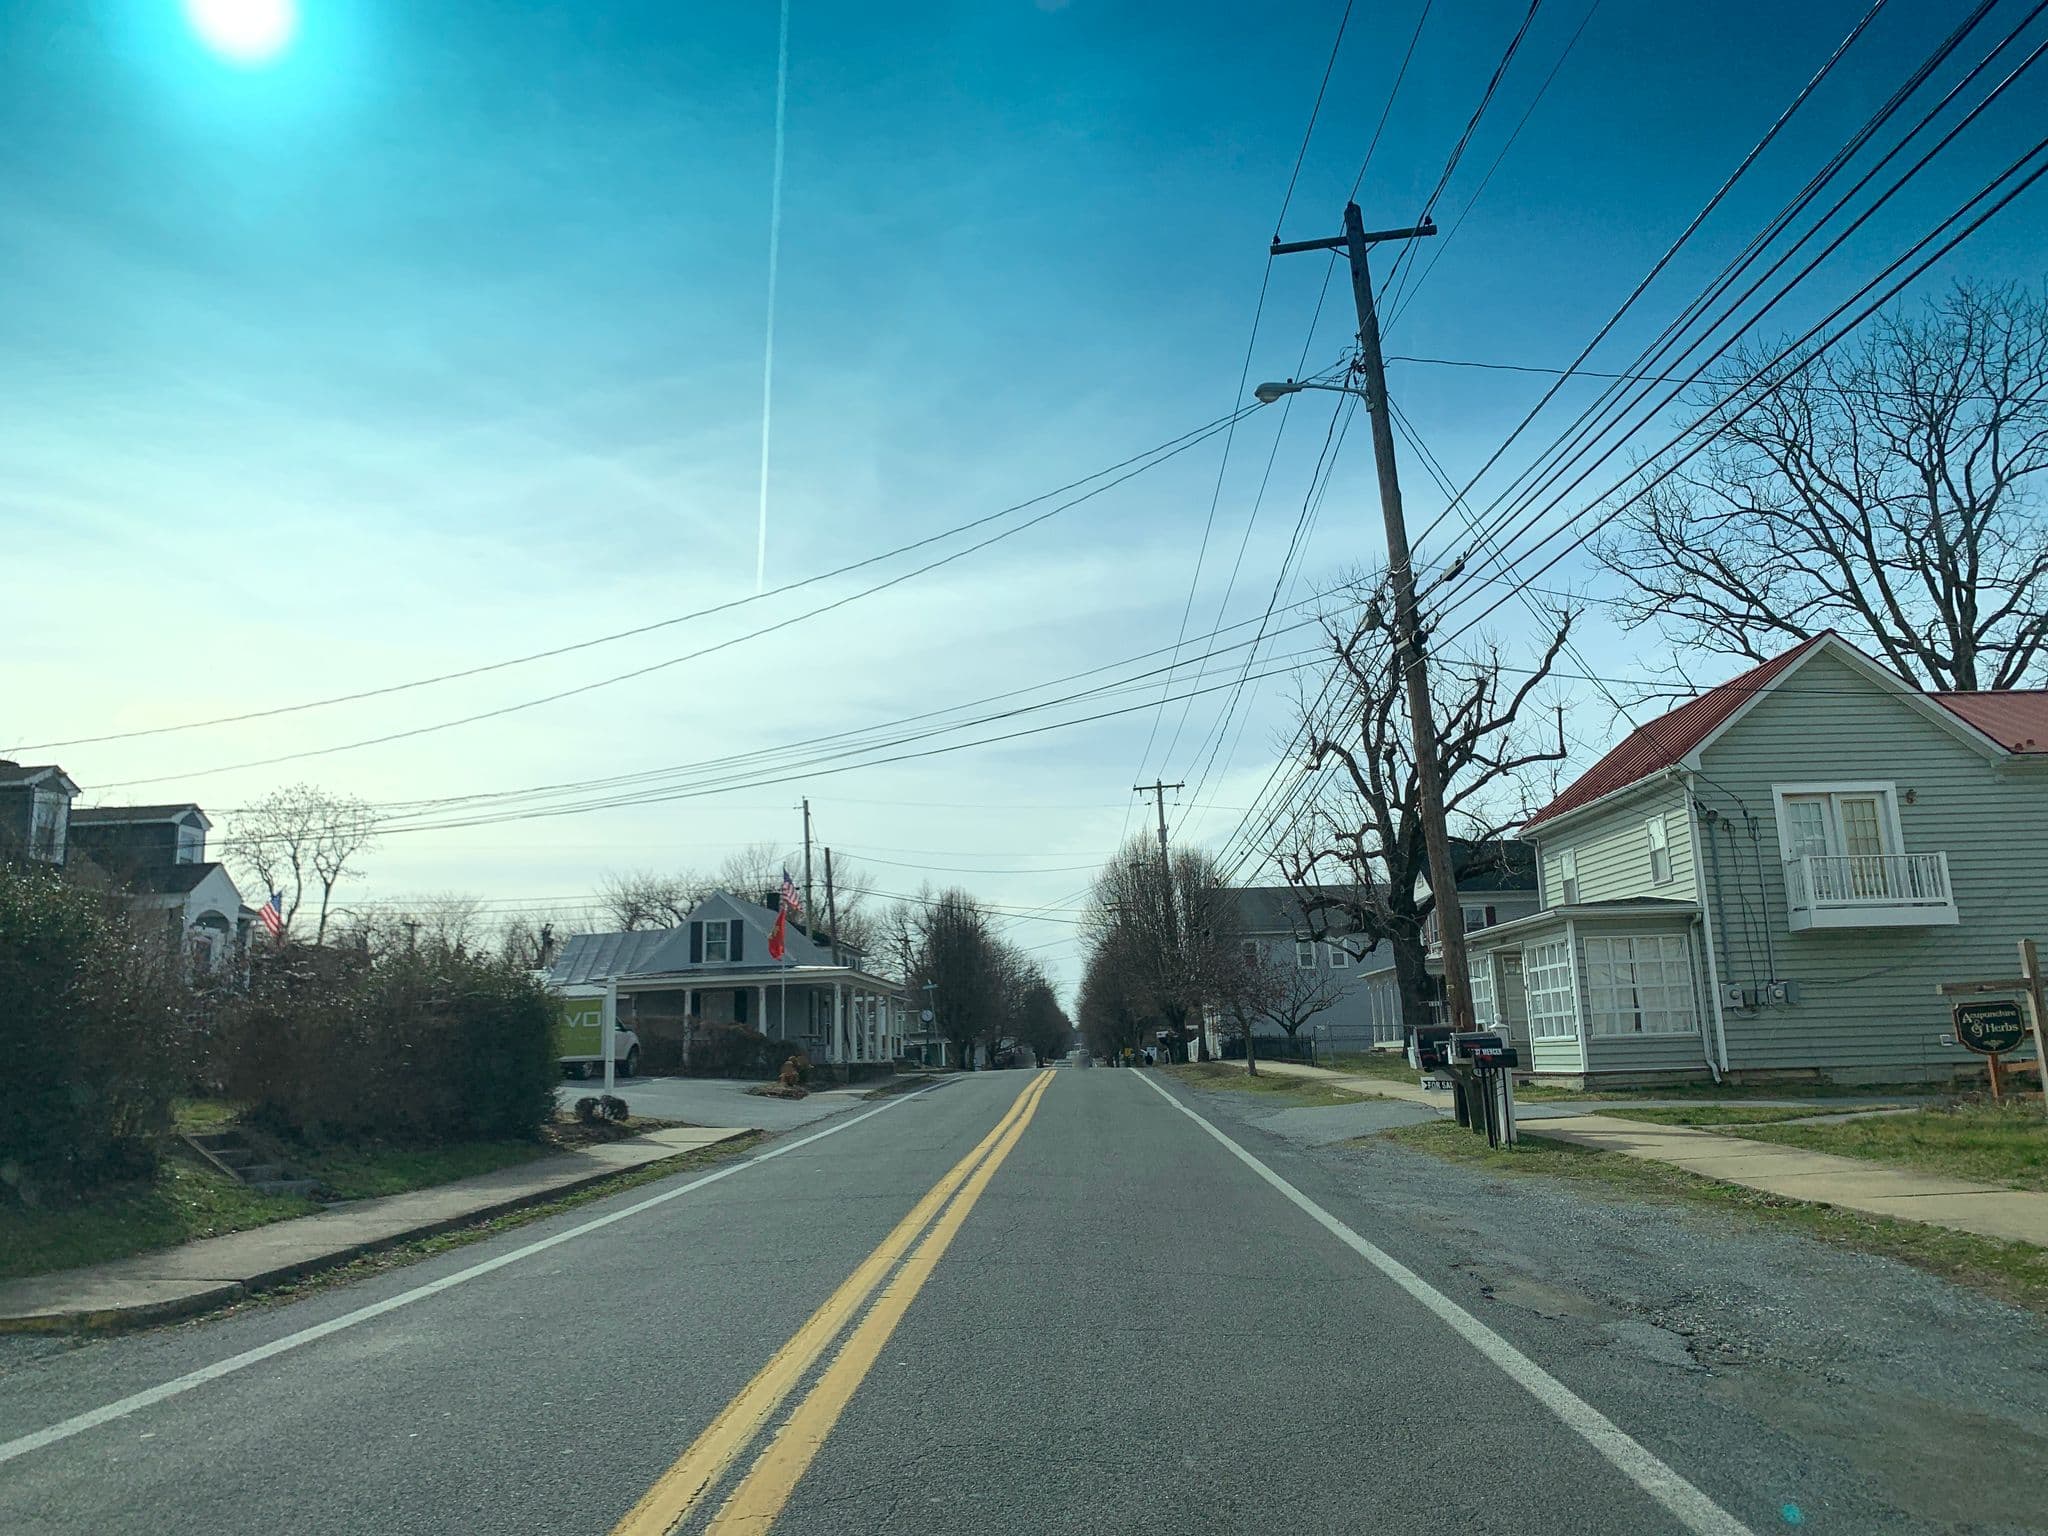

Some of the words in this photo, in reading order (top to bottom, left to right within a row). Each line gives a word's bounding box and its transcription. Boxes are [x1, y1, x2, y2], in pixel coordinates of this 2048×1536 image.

[1962, 1010, 2016, 1023] Acupuncture
[1971, 1019, 1983, 1037] &
[1985, 1023, 2019, 1032] Herbs
[1427, 1081, 1441, 1089] FOR
[1442, 1081, 1454, 1089] SAL
